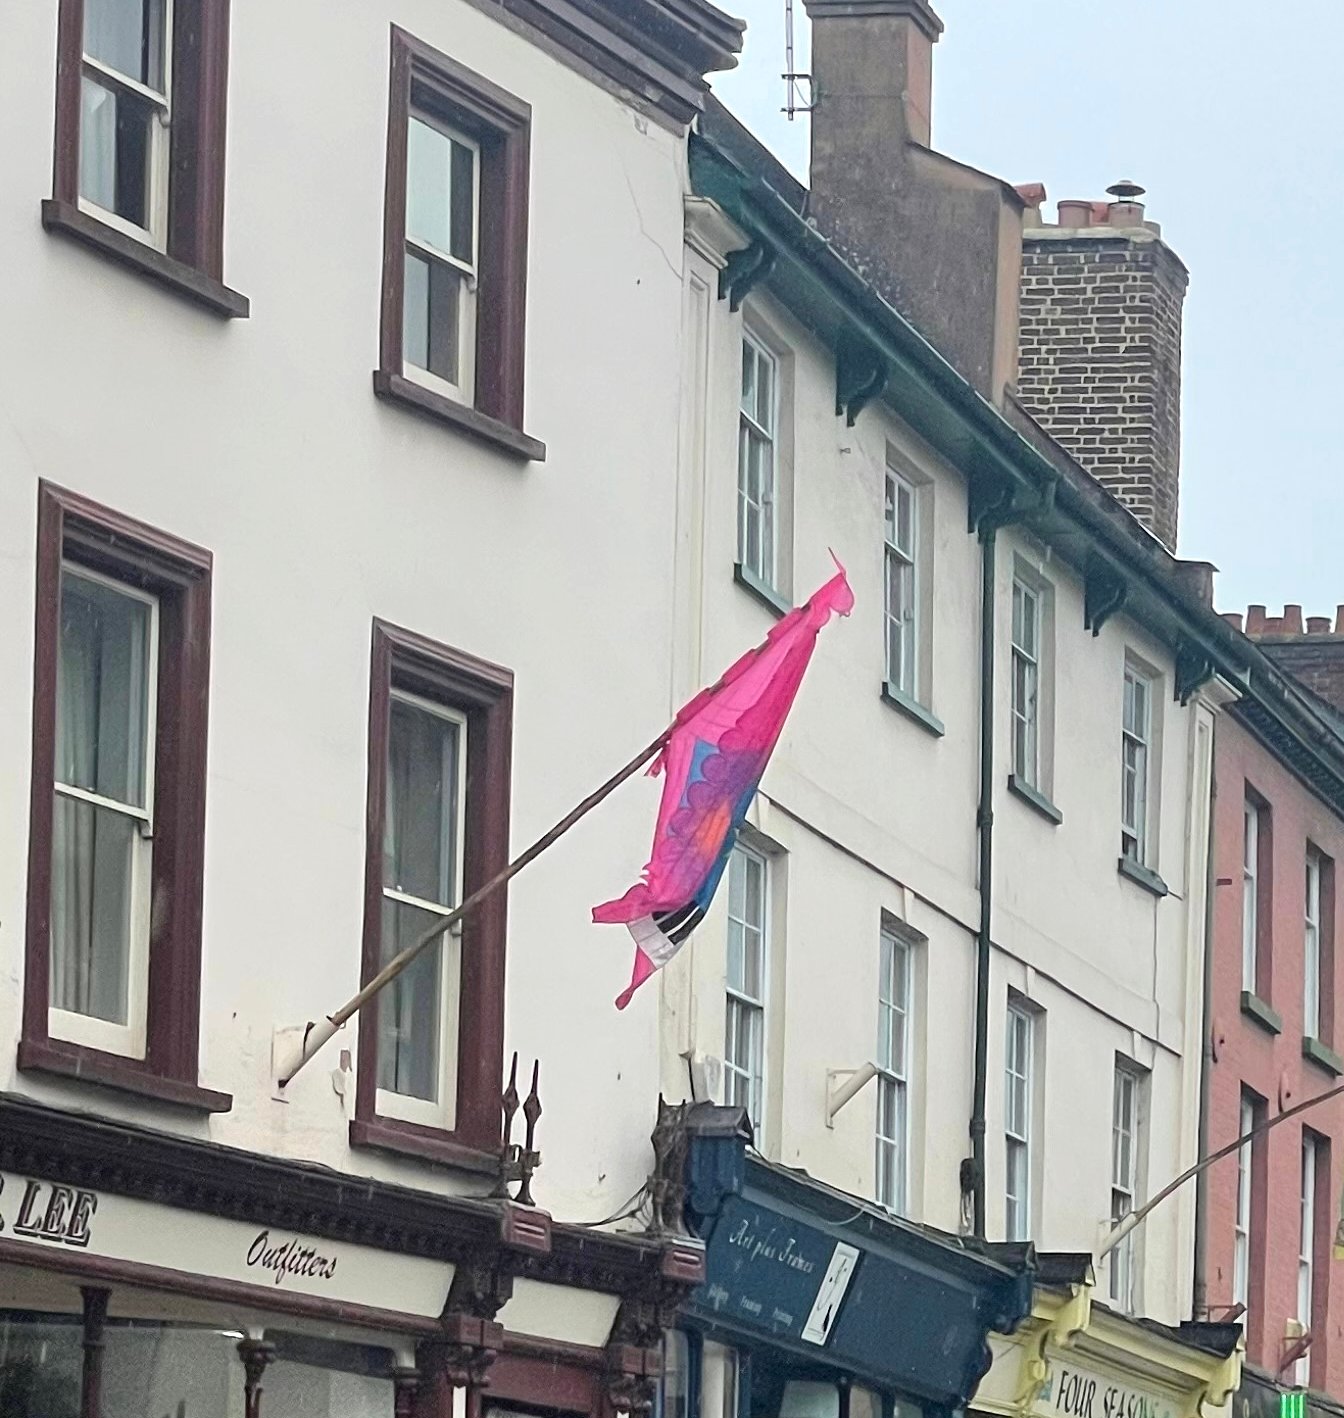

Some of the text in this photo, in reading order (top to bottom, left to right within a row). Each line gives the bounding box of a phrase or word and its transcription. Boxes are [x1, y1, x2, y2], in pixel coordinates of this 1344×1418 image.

[13, 1180, 98, 1247] LEE
[246, 1230, 337, 1285] Outfitters
[729, 1219, 816, 1274] Art plus Frames
